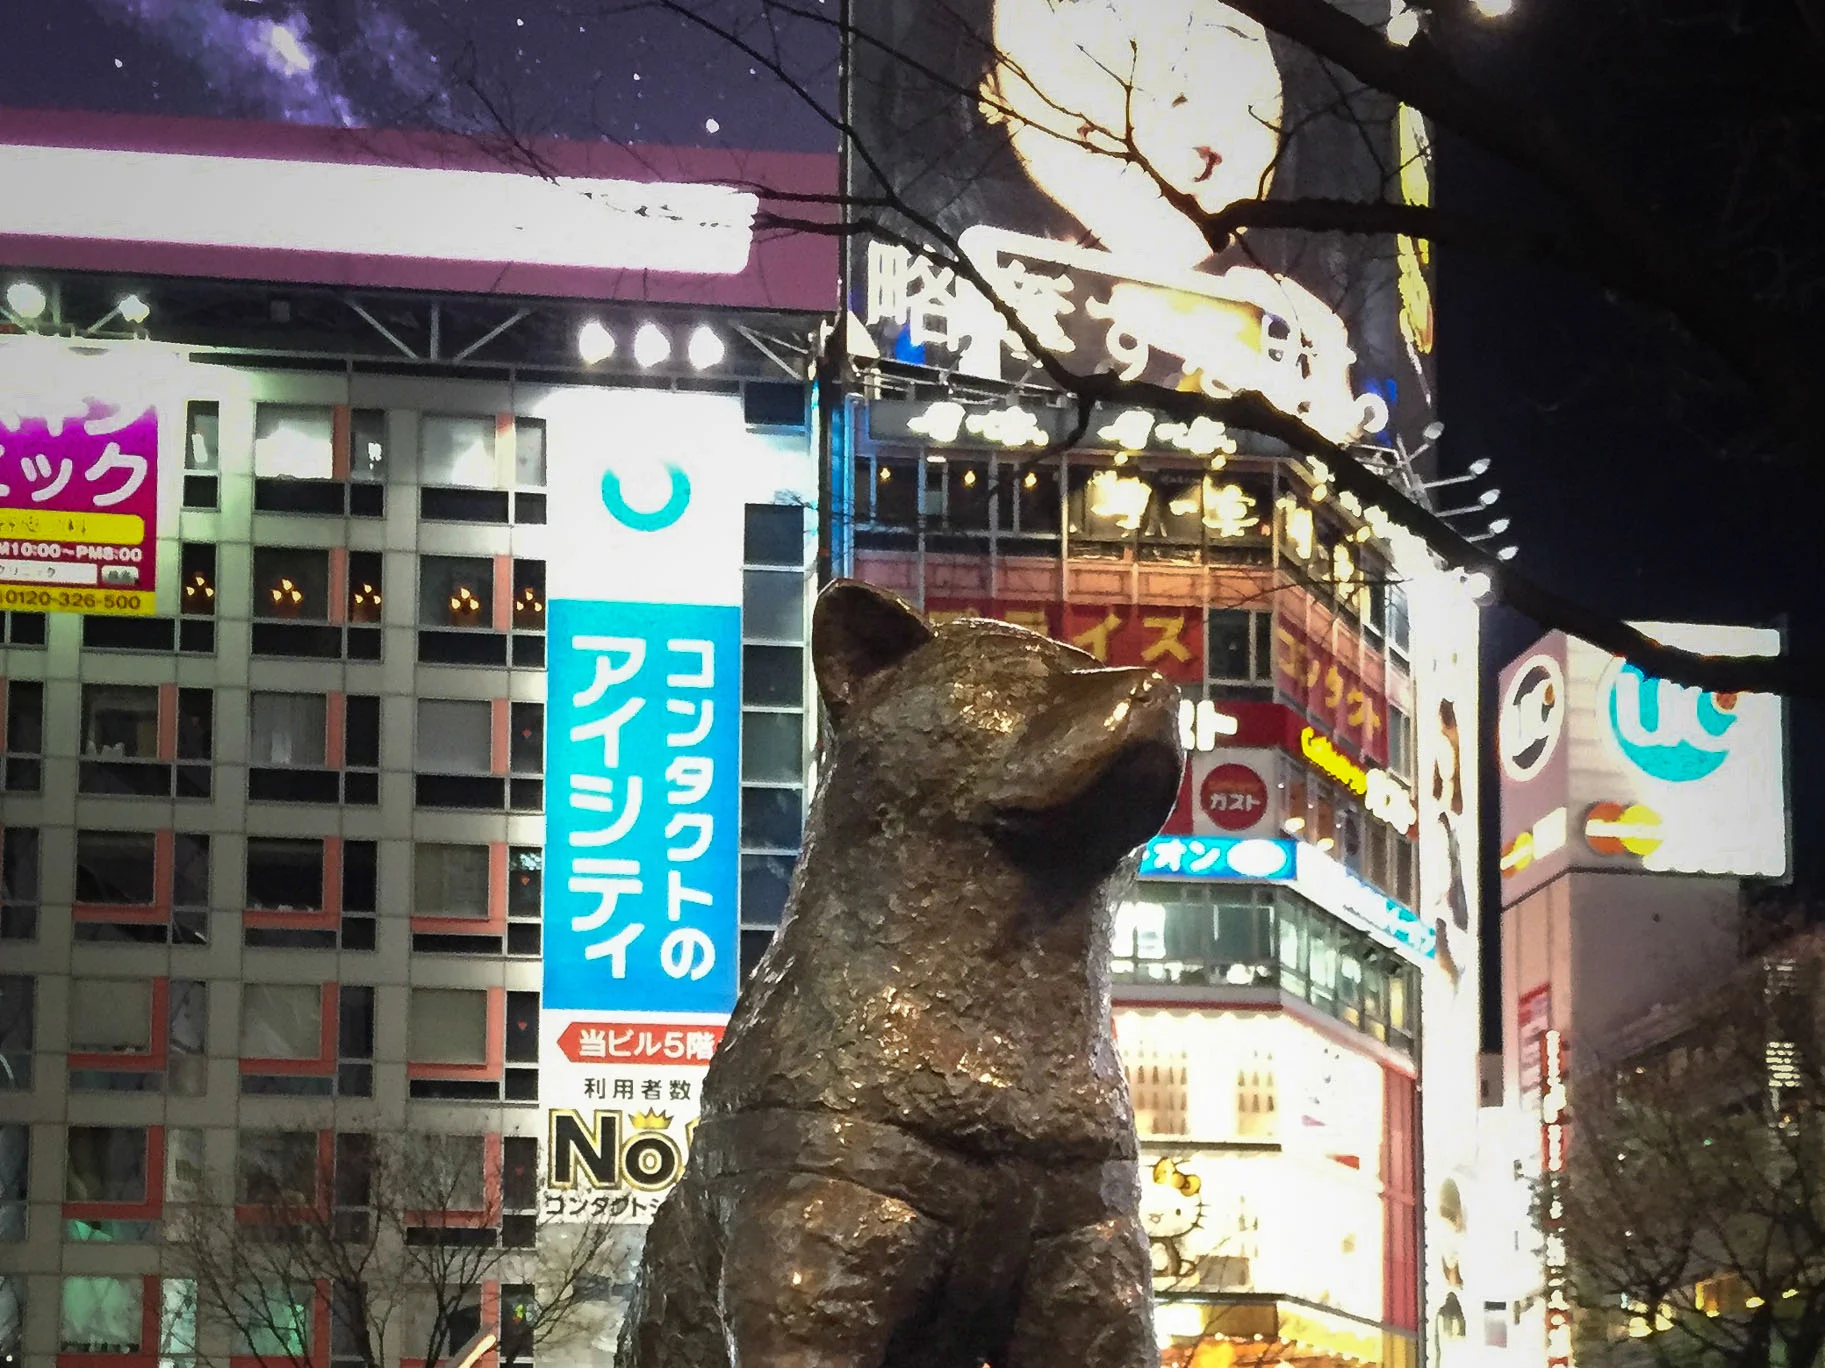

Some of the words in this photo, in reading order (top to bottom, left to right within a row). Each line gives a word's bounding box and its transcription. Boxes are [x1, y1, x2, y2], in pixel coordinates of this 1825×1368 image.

[0, 441, 148, 507] ック
[568, 635, 646, 979] アイシティ
[660, 639, 716, 981] コンタクトの
[579, 1028, 716, 1061] 当ビル5階
[584, 1077, 691, 1101] 利用者数
